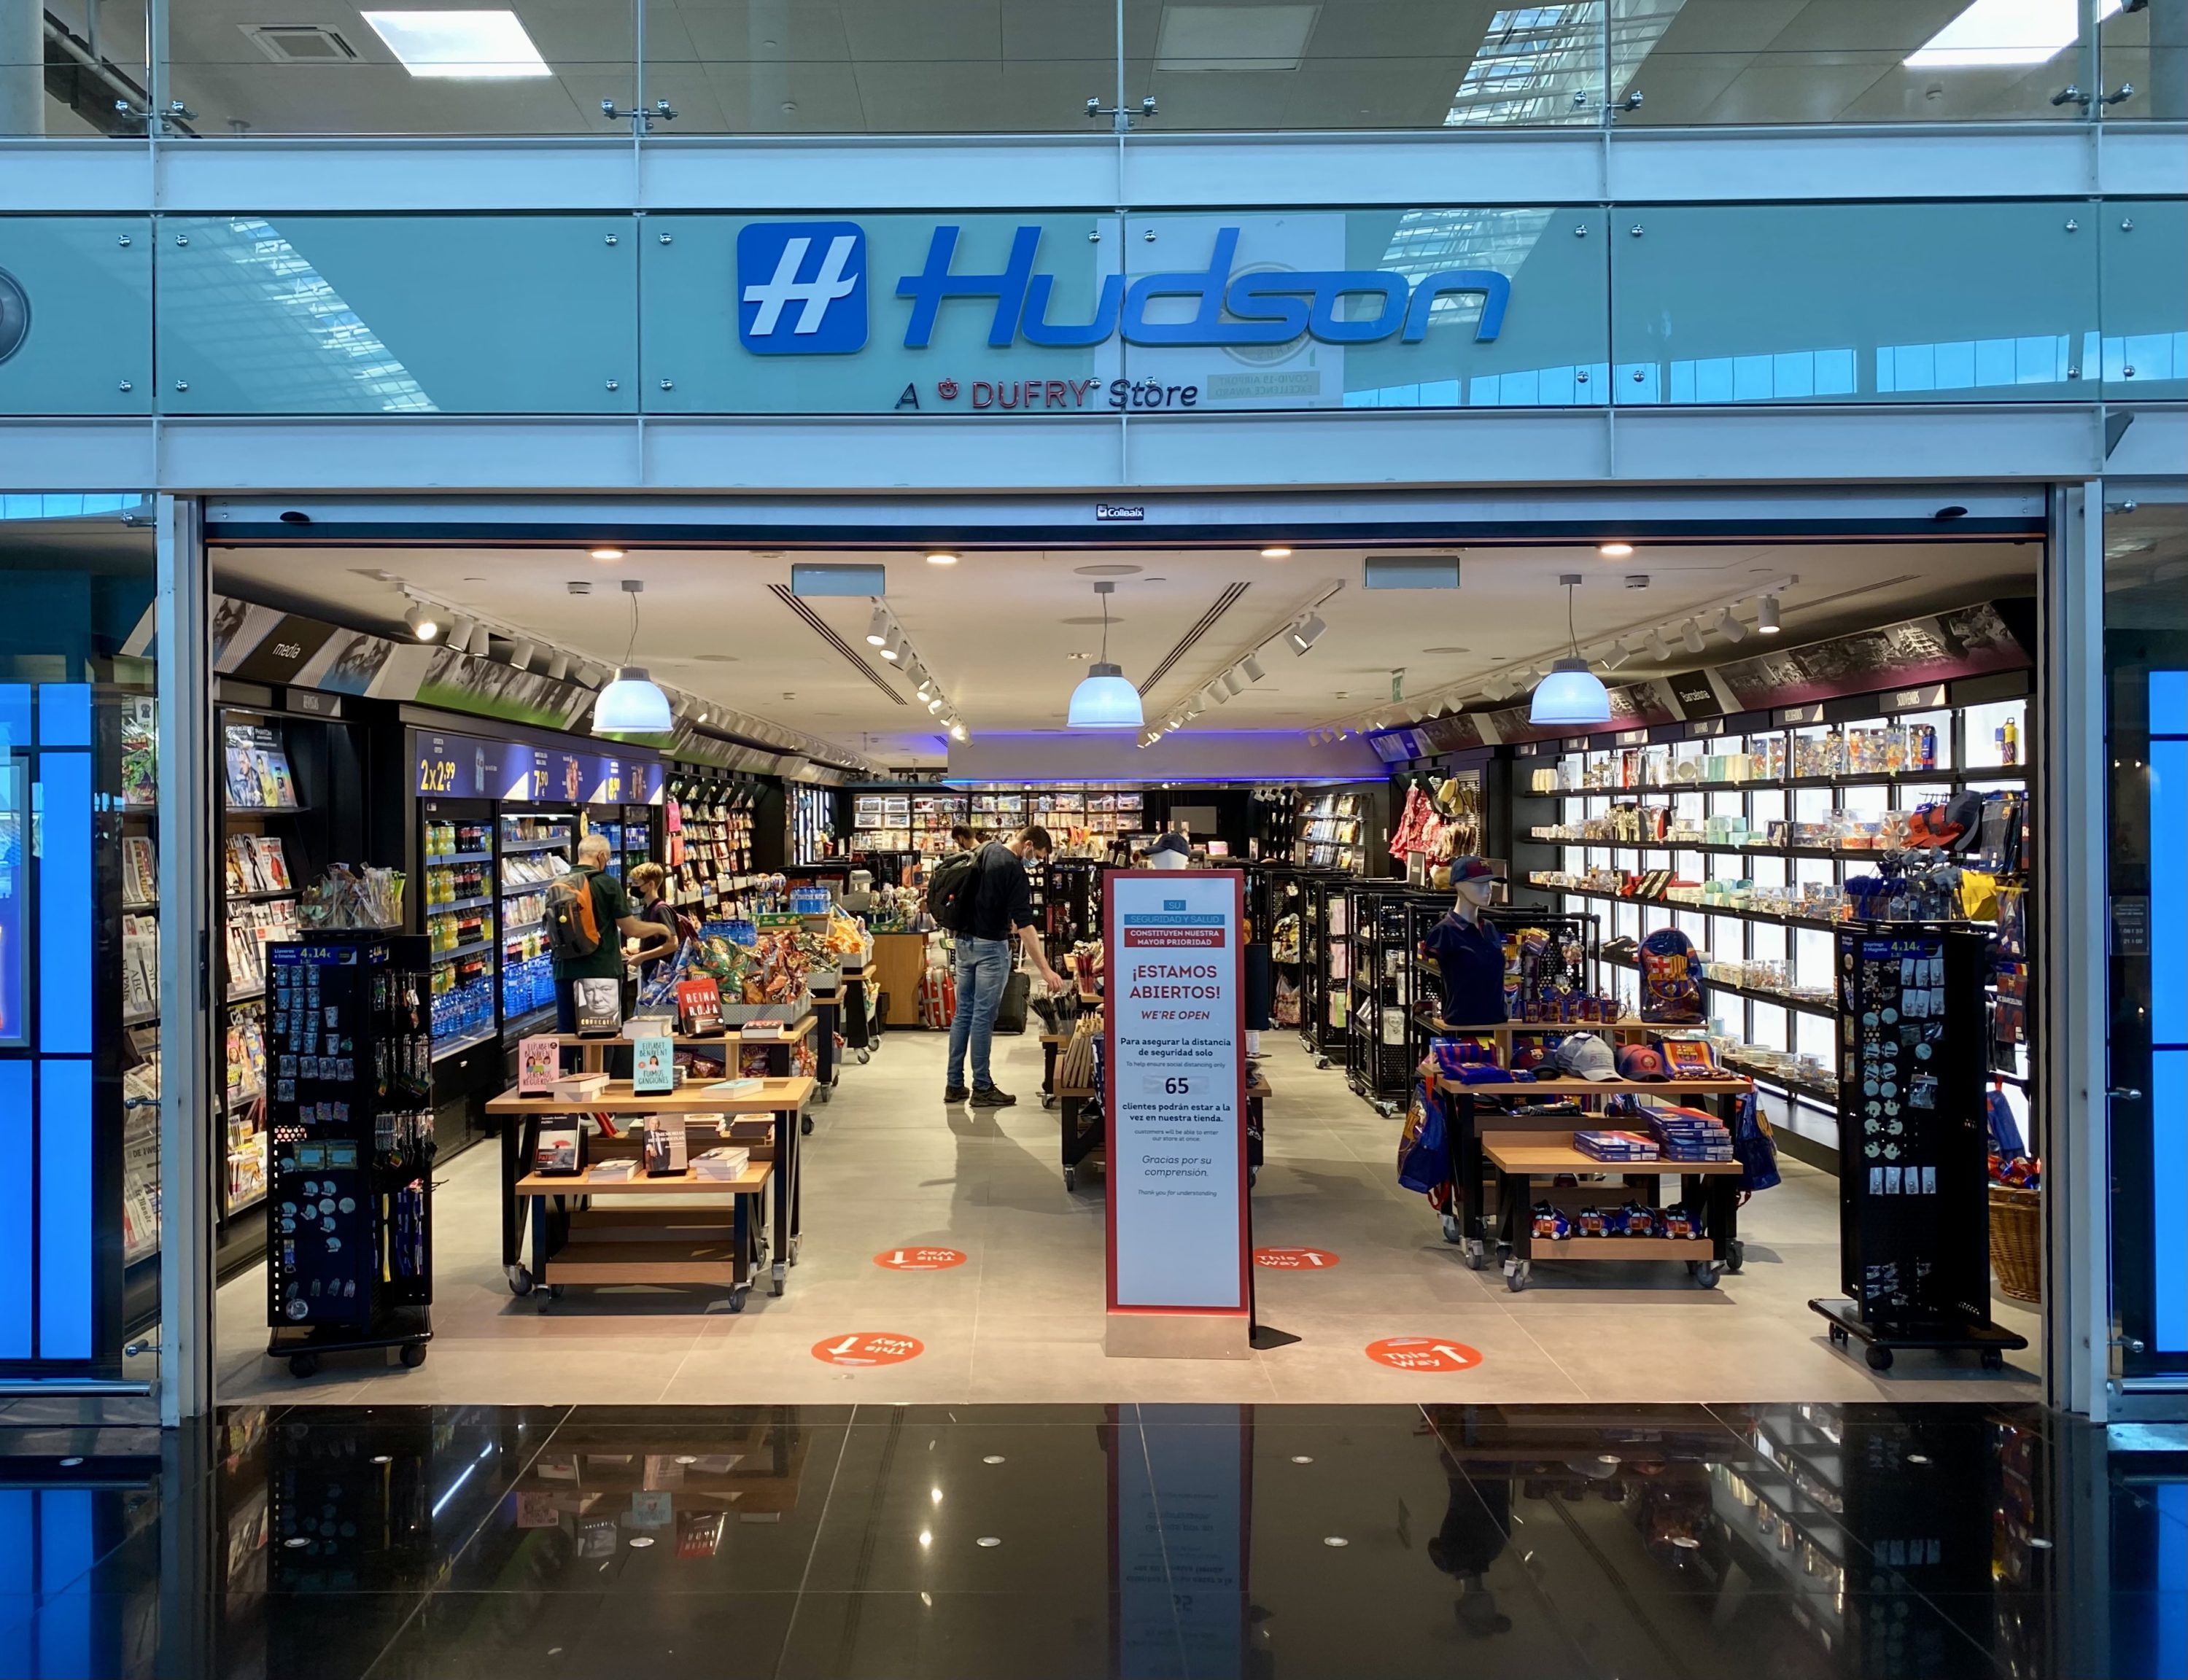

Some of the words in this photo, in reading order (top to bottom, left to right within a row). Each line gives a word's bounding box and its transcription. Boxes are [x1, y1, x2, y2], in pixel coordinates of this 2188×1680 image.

[896, 226, 1511, 348] Hudson
[894, 381, 920, 409] A
[971, 380, 1090, 408] DUFRY
[1108, 378, 1198, 407] Store
[272, 642, 301, 659] media
[1679, 689, 1711, 702] Barcelona
[1168, 901, 1181, 909] SU
[1130, 915, 1182, 923] SEGURIDAD
[1133, 965, 1217, 981] ¡ESTAMOS
[131, 968, 144, 997] ABC
[685, 991, 716, 1003] REINA
[1130, 986, 1220, 999] ABIERTOS!
[1141, 1011, 1176, 1019] WE'RE
[1178, 1011, 1210, 1020] OPEN
[1142, 1039, 1180, 1047] asegurar
[1151, 1049, 1193, 1057] seguridad
[1165, 1077, 1189, 1094] 65
[1122, 1102, 1157, 1111] clientes
[1158, 1102, 1189, 1112] podrán
[1194, 1114, 1223, 1122] tienda.
[1141, 1155, 1179, 1164] Gracias
[1181, 1156, 1198, 1166] por
[1144, 1167, 1209, 1178] comprensión.
[138, 1196, 152, 1224] Monde
[870, 1337, 914, 1348] Way
[864, 1345, 905, 1355] This
[1381, 1351, 1430, 1360] This
[1392, 1359, 1440, 1368] Way
